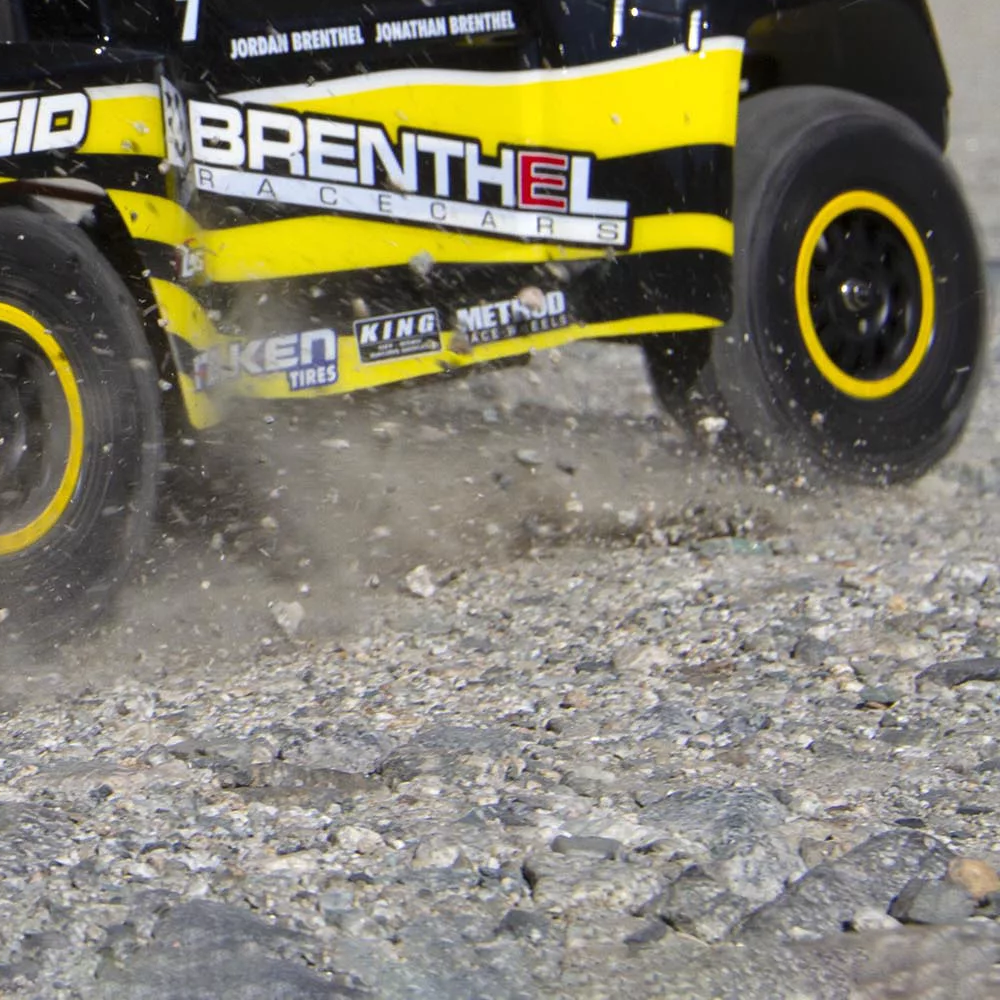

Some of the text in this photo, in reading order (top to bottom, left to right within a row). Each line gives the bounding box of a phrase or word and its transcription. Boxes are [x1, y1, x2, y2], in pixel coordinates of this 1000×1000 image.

[230, 25, 364, 60] JORDAN BRENTHEL
[375, 10, 515, 43] JONATHAN BRENTHEL
[189, 100, 629, 218] BRENTHEL
[198, 168, 620, 242] RACECARS
[360, 313, 435, 345] KING
[465, 326, 500, 345] ACE
[289, 365, 336, 390] TIRES
